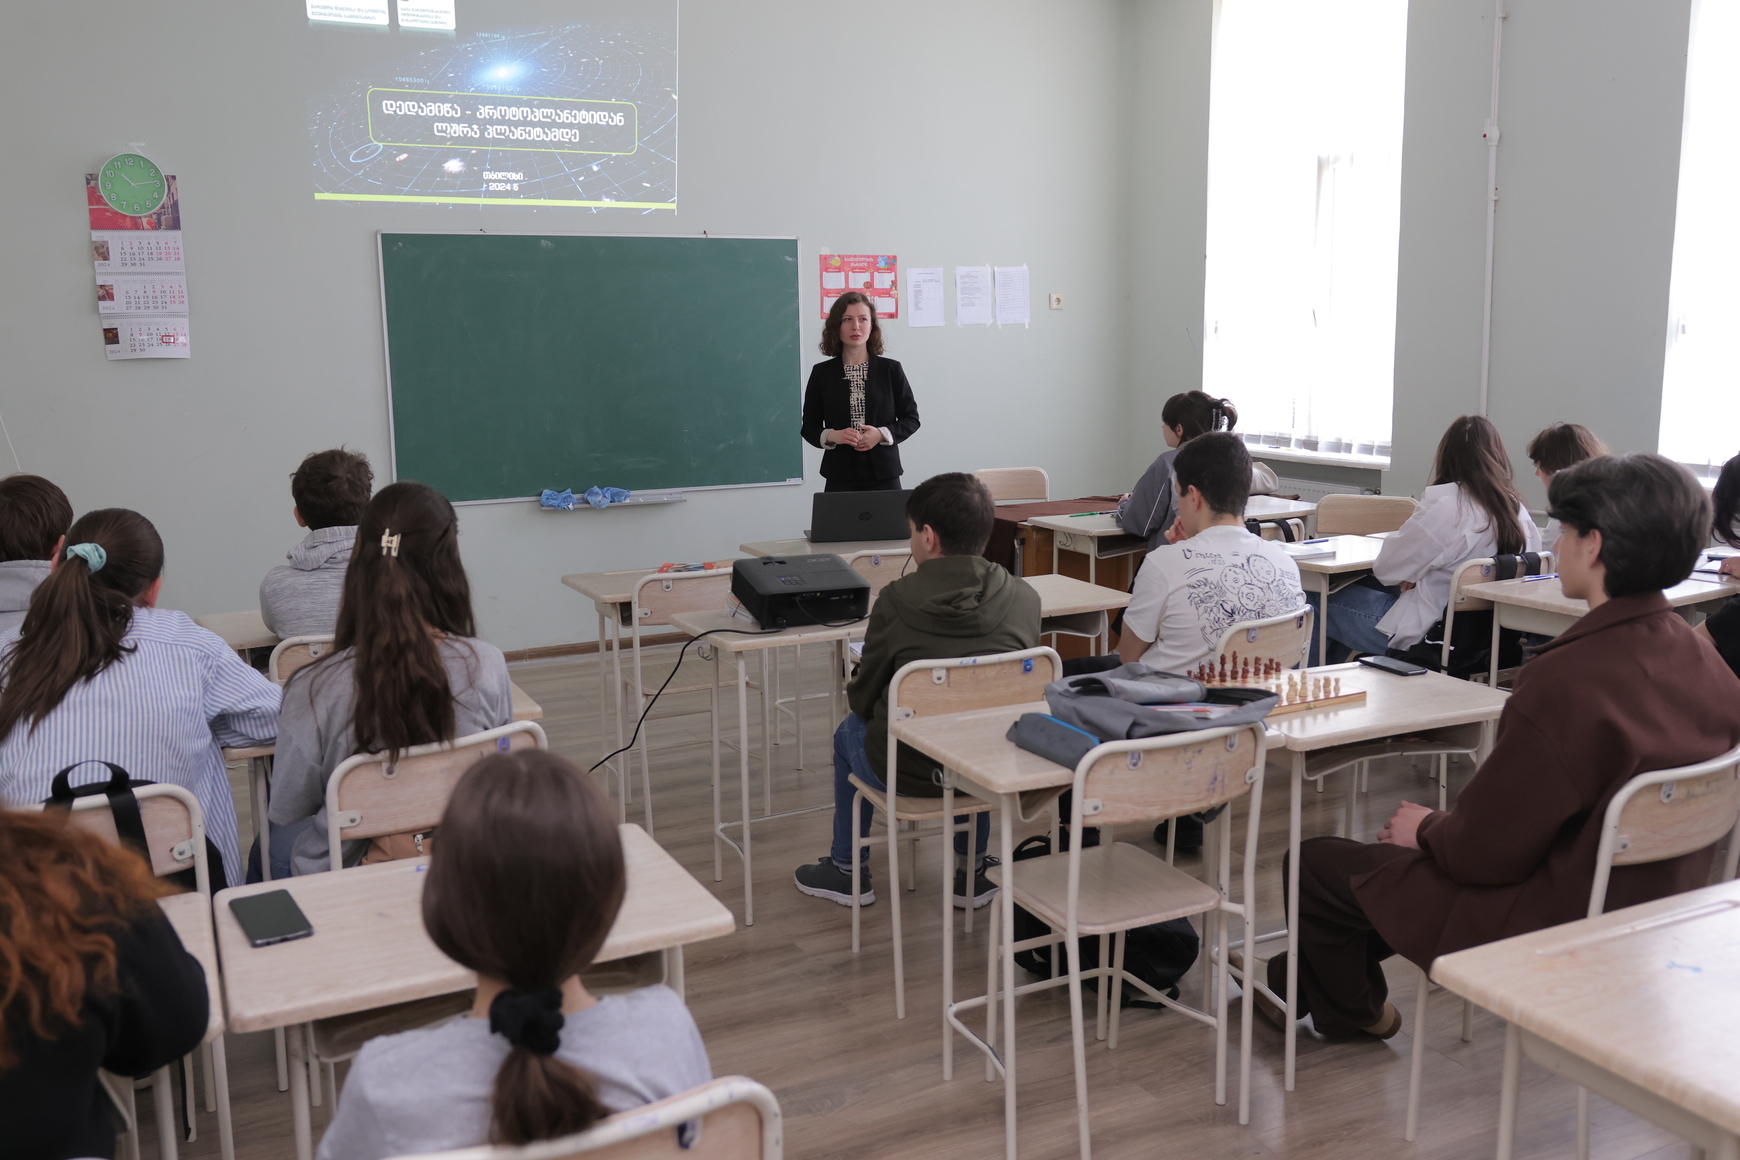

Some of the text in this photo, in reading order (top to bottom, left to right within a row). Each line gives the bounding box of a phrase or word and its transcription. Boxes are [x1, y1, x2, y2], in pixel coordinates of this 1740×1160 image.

[382, 100, 461, 117] დედამიწა
[476, 105, 624, 126] პროტოპლანეტიდან
[485, 126, 579, 142] პლანეტამდე
[1182, 549, 1222, 559] Vincent
